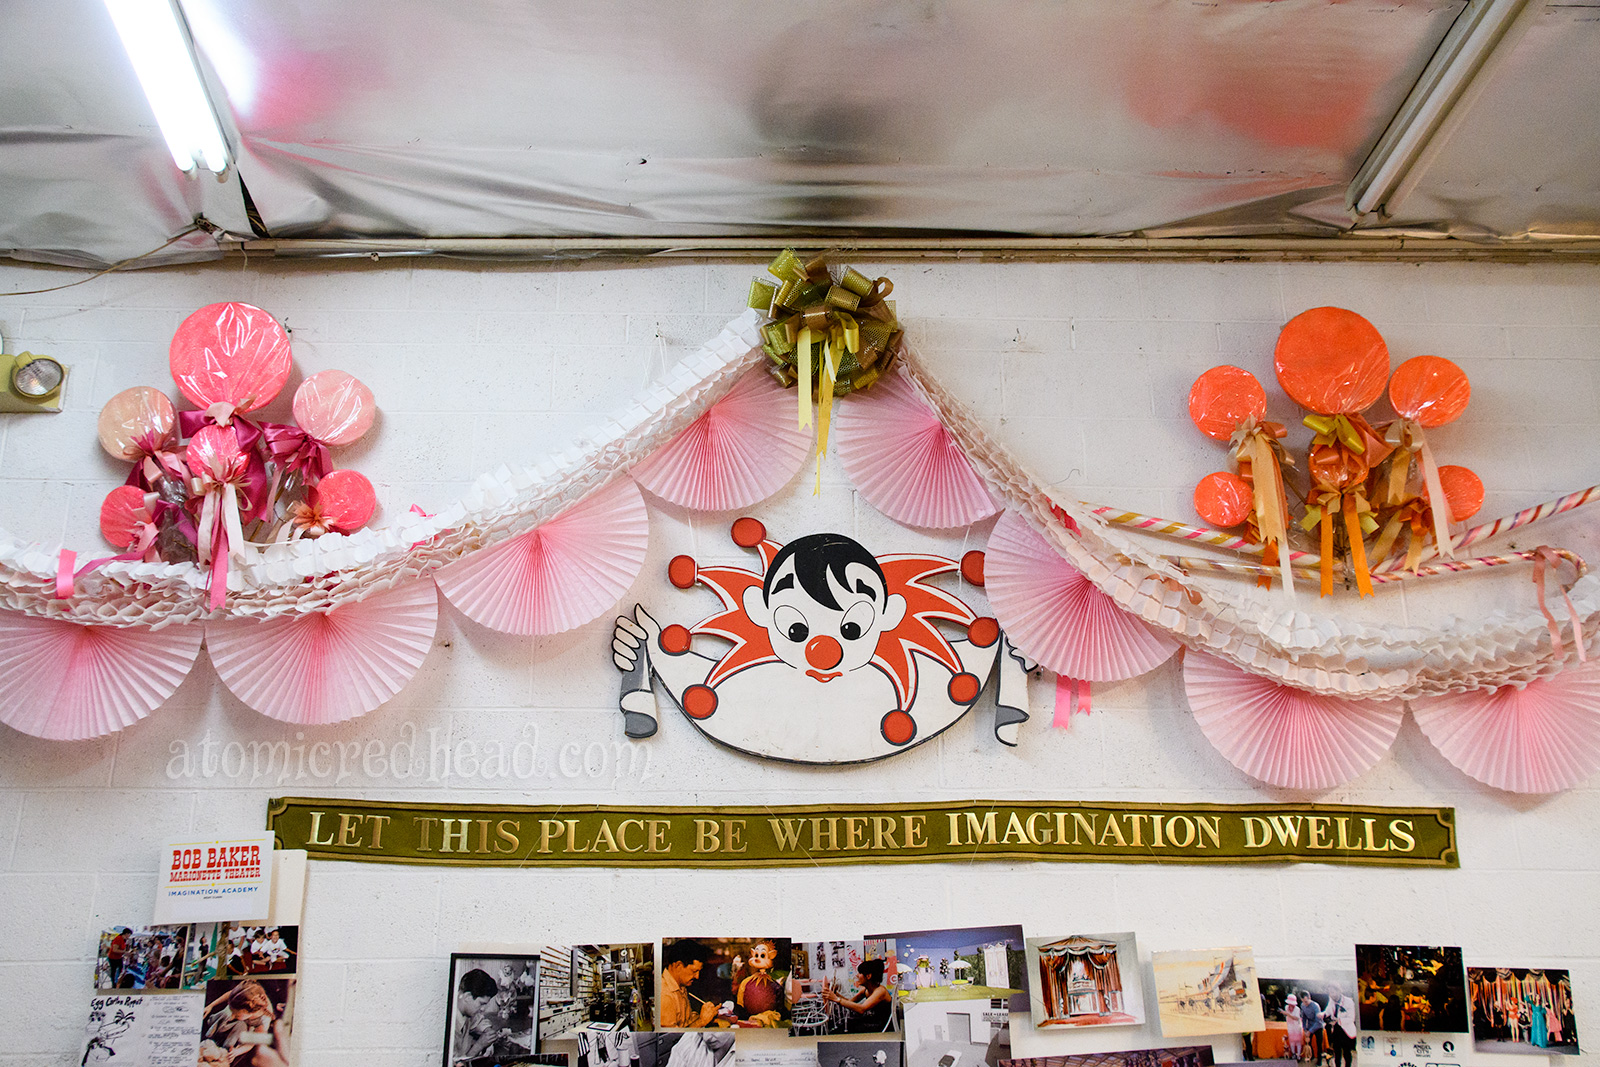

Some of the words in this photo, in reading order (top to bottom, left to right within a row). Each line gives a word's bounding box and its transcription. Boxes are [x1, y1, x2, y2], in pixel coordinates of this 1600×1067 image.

[306, 811, 390, 850] LET
[413, 816, 520, 855] THIS
[537, 818, 671, 854] PLACE
[694, 819, 748, 854] BE
[770, 814, 929, 854] WHERE
[946, 811, 1221, 849] IMAGINATION
[1244, 815, 1416, 854] DWELLS
[171, 848, 202, 870] BOB
[206, 845, 261, 868] BAKER
[169, 869, 221, 882] MARIONETTE
[224, 867, 261, 879] THEATER
[168, 888, 219, 897] IMAGINATION
[221, 886, 258, 894] ACADEMY
[90, 997, 104, 1011] Egg
